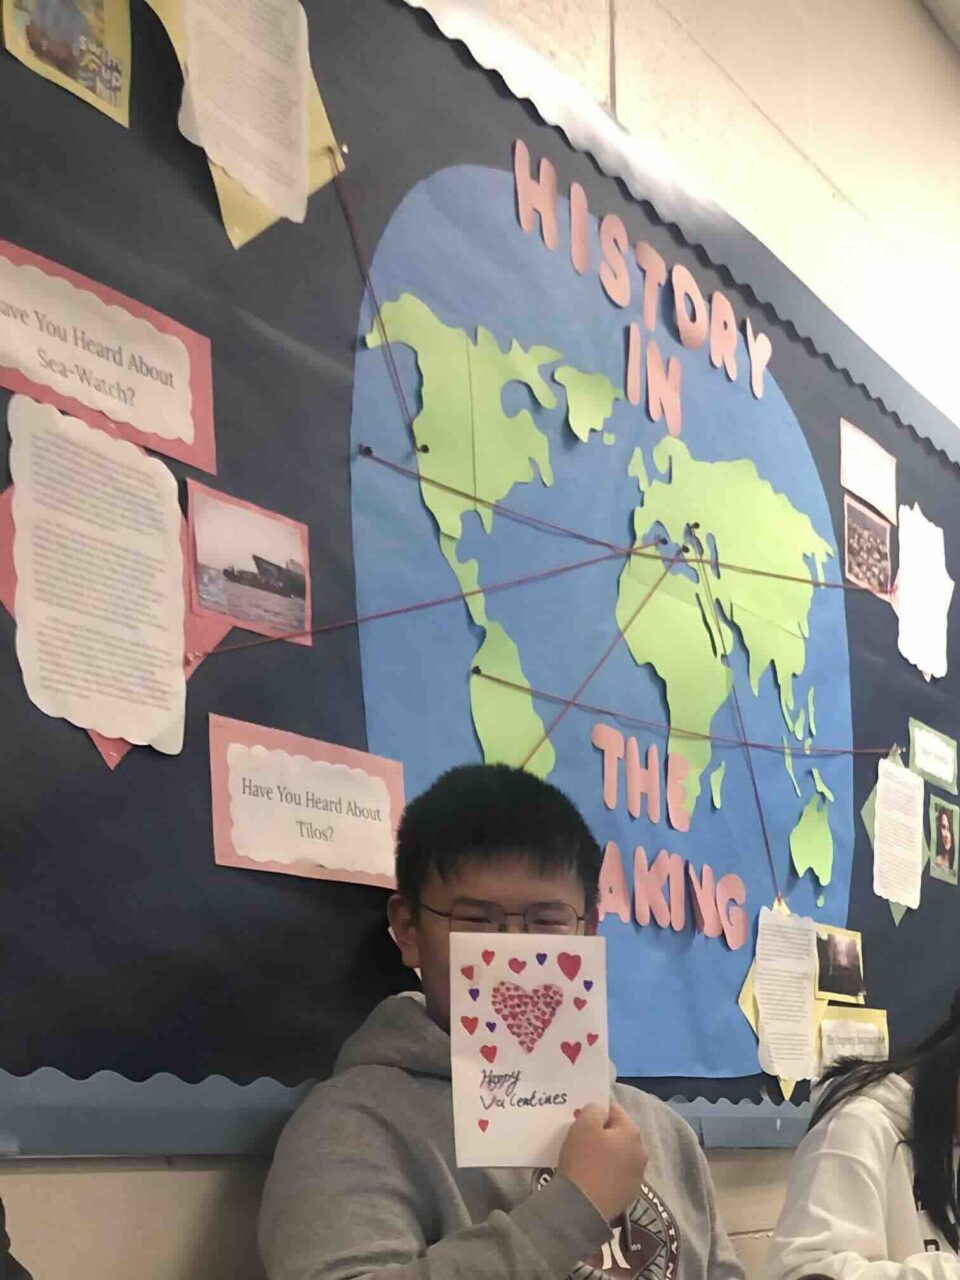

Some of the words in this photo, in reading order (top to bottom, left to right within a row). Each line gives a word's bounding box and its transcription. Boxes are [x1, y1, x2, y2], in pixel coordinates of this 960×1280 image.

[513, 138, 772, 400] HISTORY
[0, 301, 30, 324] ave
[33, 309, 68, 343] You
[72, 326, 123, 368] Heard
[128, 353, 176, 391] About
[36, 347, 136, 408] Sea-Watch?
[626, 321, 682, 437] IN
[241, 776, 275, 801] Have
[276, 784, 302, 807] You
[304, 790, 343, 815] Heard
[346, 800, 383, 823] About
[296, 819, 336, 844] Tilos?
[592, 840, 748, 951] AKING
[479, 1068, 521, 1097] Happy
[479, 1089, 568, 1111] Valentines
